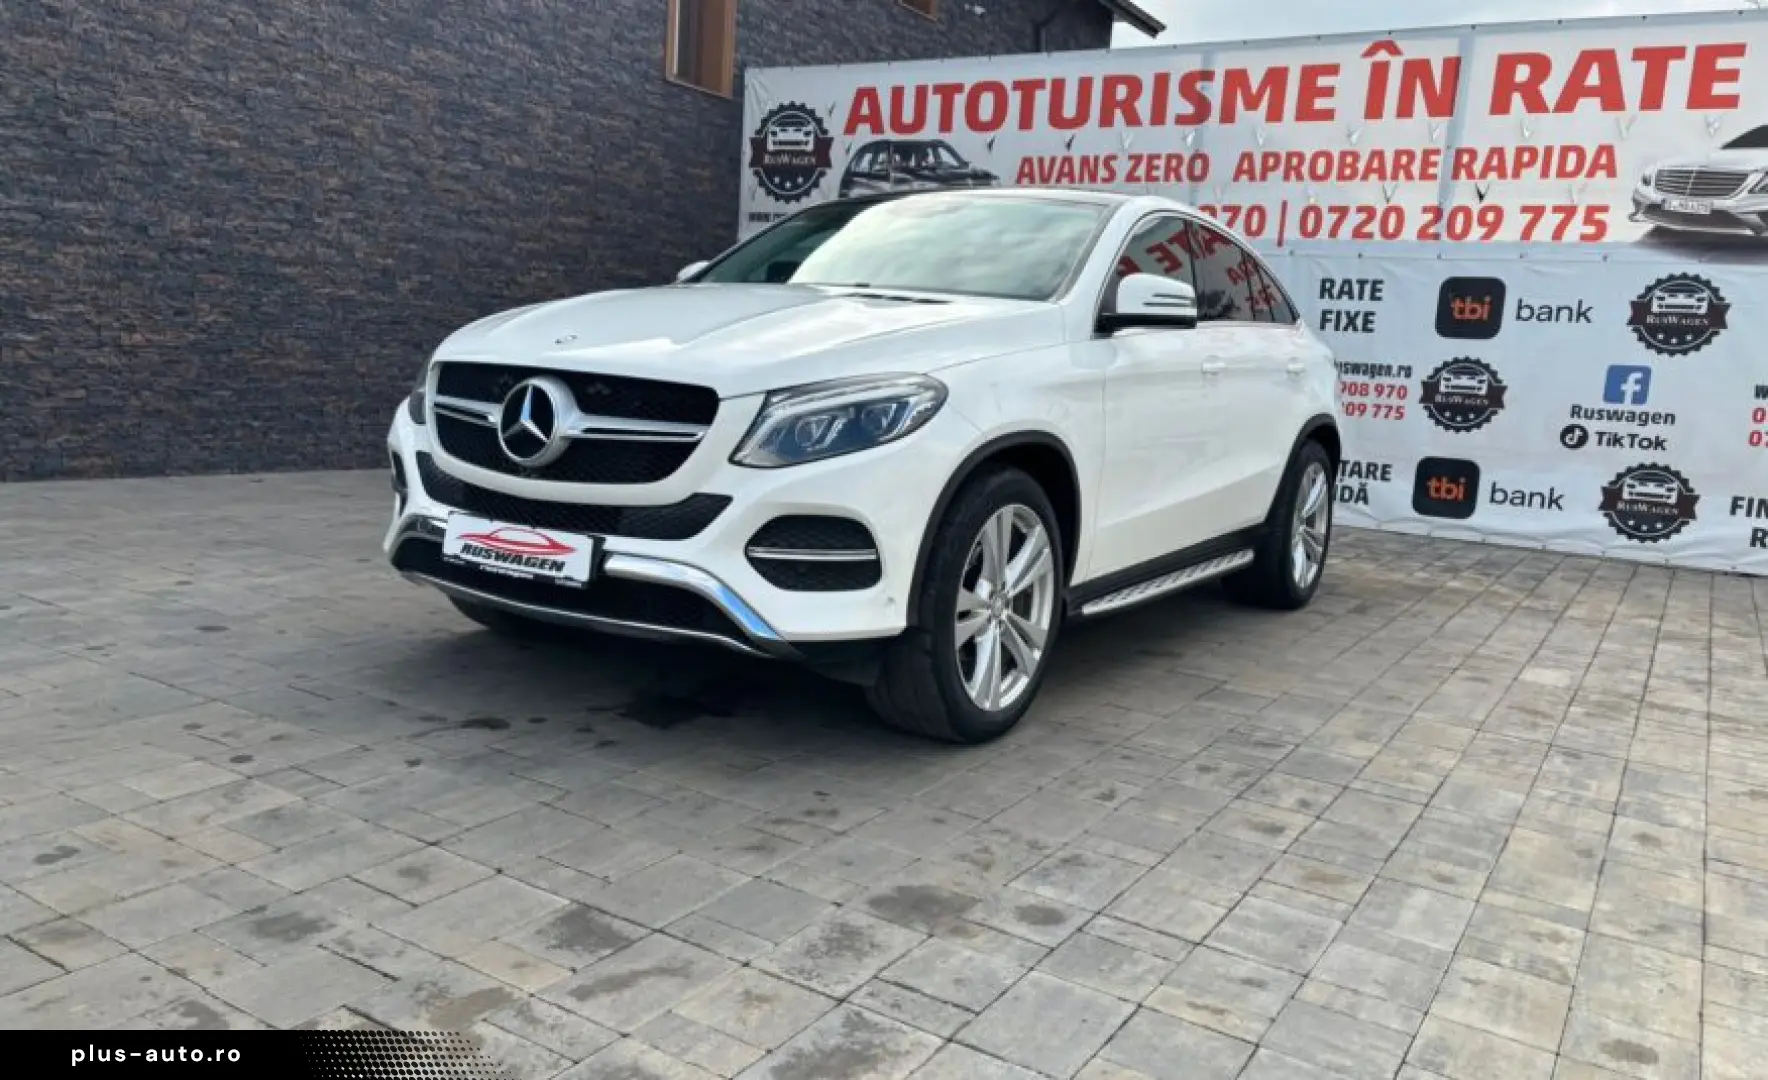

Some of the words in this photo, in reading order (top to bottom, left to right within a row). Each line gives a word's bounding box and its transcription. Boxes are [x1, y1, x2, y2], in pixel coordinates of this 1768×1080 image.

[844, 63, 1340, 136] AUTOTURISME
[1361, 40, 1461, 120] ÎN
[1489, 43, 1746, 115] RATE
[1016, 154, 1118, 185] AVANS
[1124, 149, 1210, 184] ZERO
[1232, 148, 1441, 183] APROBARE
[1452, 144, 1617, 181] RAPIDA
[1299, 205, 1405, 240] 0720
[1416, 205, 1505, 241] 209
[1519, 205, 1611, 241] 775
[1319, 277, 1384, 301] RATE
[1319, 309, 1377, 334] FIXE
[1450, 295, 1491, 321] tbi
[1515, 298, 1594, 324] bank
[1374, 383, 1408, 401] 970
[1341, 401, 1367, 418] 09
[1372, 403, 1405, 421] 775
[1570, 403, 1676, 427] Ruswagen
[1427, 476, 1466, 501] tbi
[1489, 481, 1565, 511] bank
